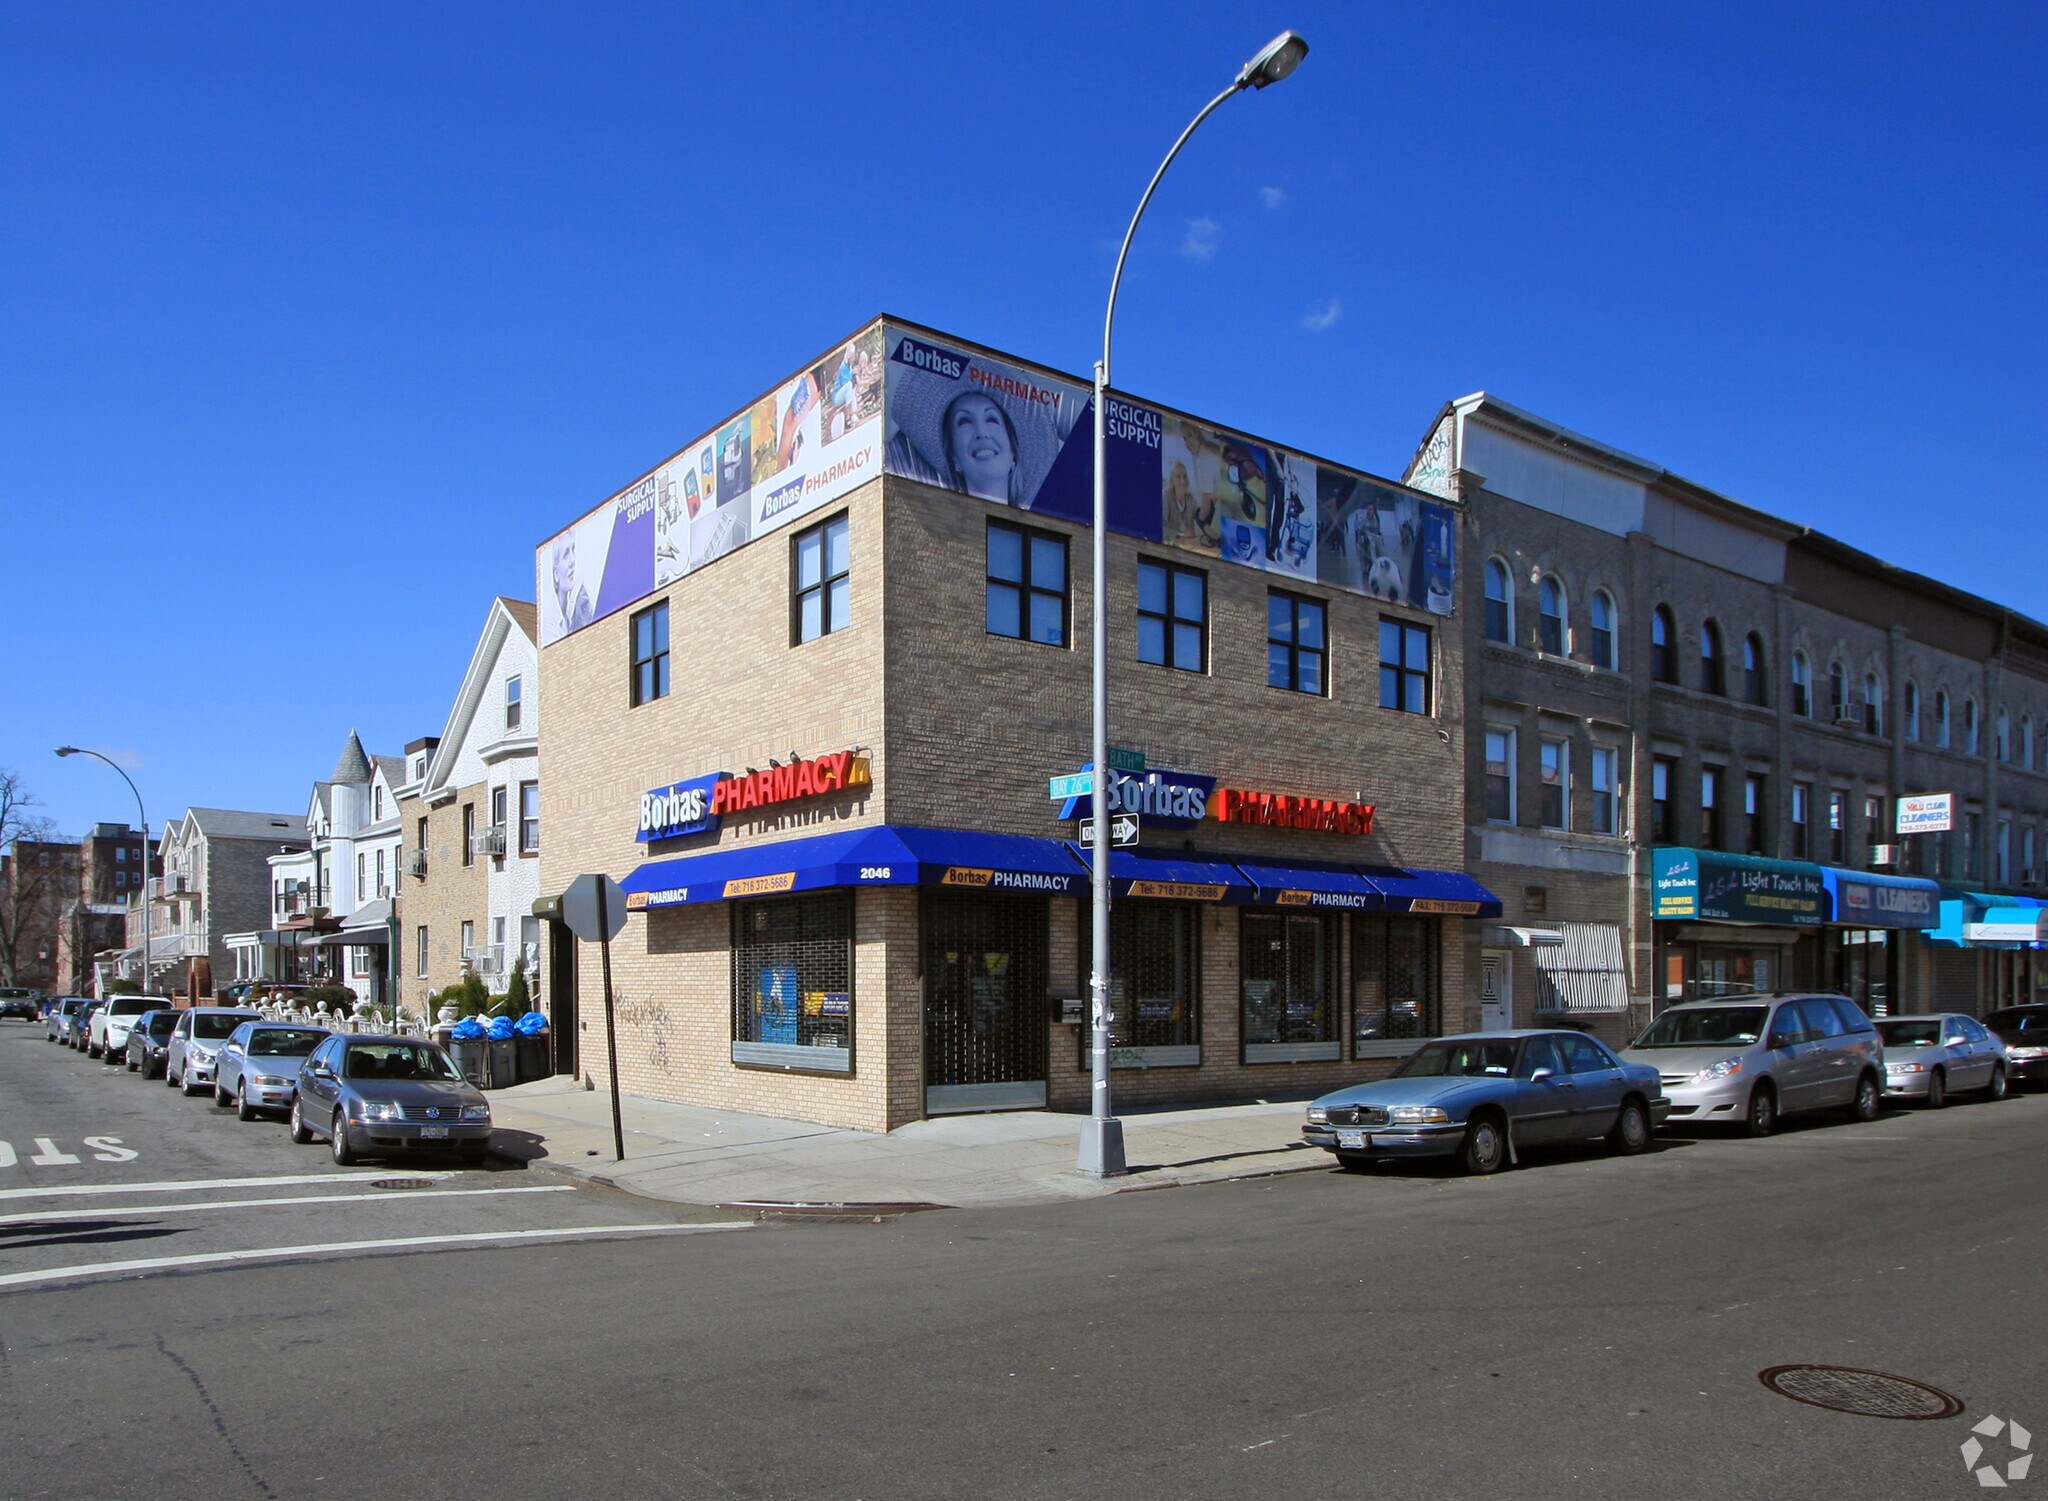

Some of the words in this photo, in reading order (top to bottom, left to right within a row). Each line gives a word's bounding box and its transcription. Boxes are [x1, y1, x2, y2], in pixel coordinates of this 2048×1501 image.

[902, 340, 961, 378] Borbas
[969, 367, 1060, 408] PHARMACY
[1108, 419, 1161, 449] SUPPLY
[765, 486, 801, 517] Borbas
[805, 446, 873, 496] PHARMACY
[618, 477, 655, 514] SURGICAL
[626, 494, 656, 524] SUPPLY
[1109, 750, 1134, 769] BATH
[640, 786, 706, 832] Borbas
[712, 751, 852, 815] PHARMACY
[1052, 778, 1068, 796] BAY
[1107, 768, 1206, 820] Borbas
[1218, 788, 1376, 835] PHARMACY
[1900, 811, 1949, 823] CLEANERS
[860, 867, 891, 879] 2046
[949, 866, 988, 885] Borbas
[994, 872, 1071, 891] PHARMACY
[1742, 871, 1769, 893] Light
[1772, 874, 1802, 891] Touch
[1804, 877, 1820, 893] Inc
[743, 880, 755, 892] 718
[1139, 883, 1154, 895] Tel:
[1158, 884, 1174, 896] 718
[1176, 885, 1219, 898] 372-5686
[627, 892, 647, 908] Borbas
[648, 888, 688, 904] PHARMACY
[1312, 892, 1367, 908] PHARMACY
[1876, 887, 1930, 914] CLEANERS
